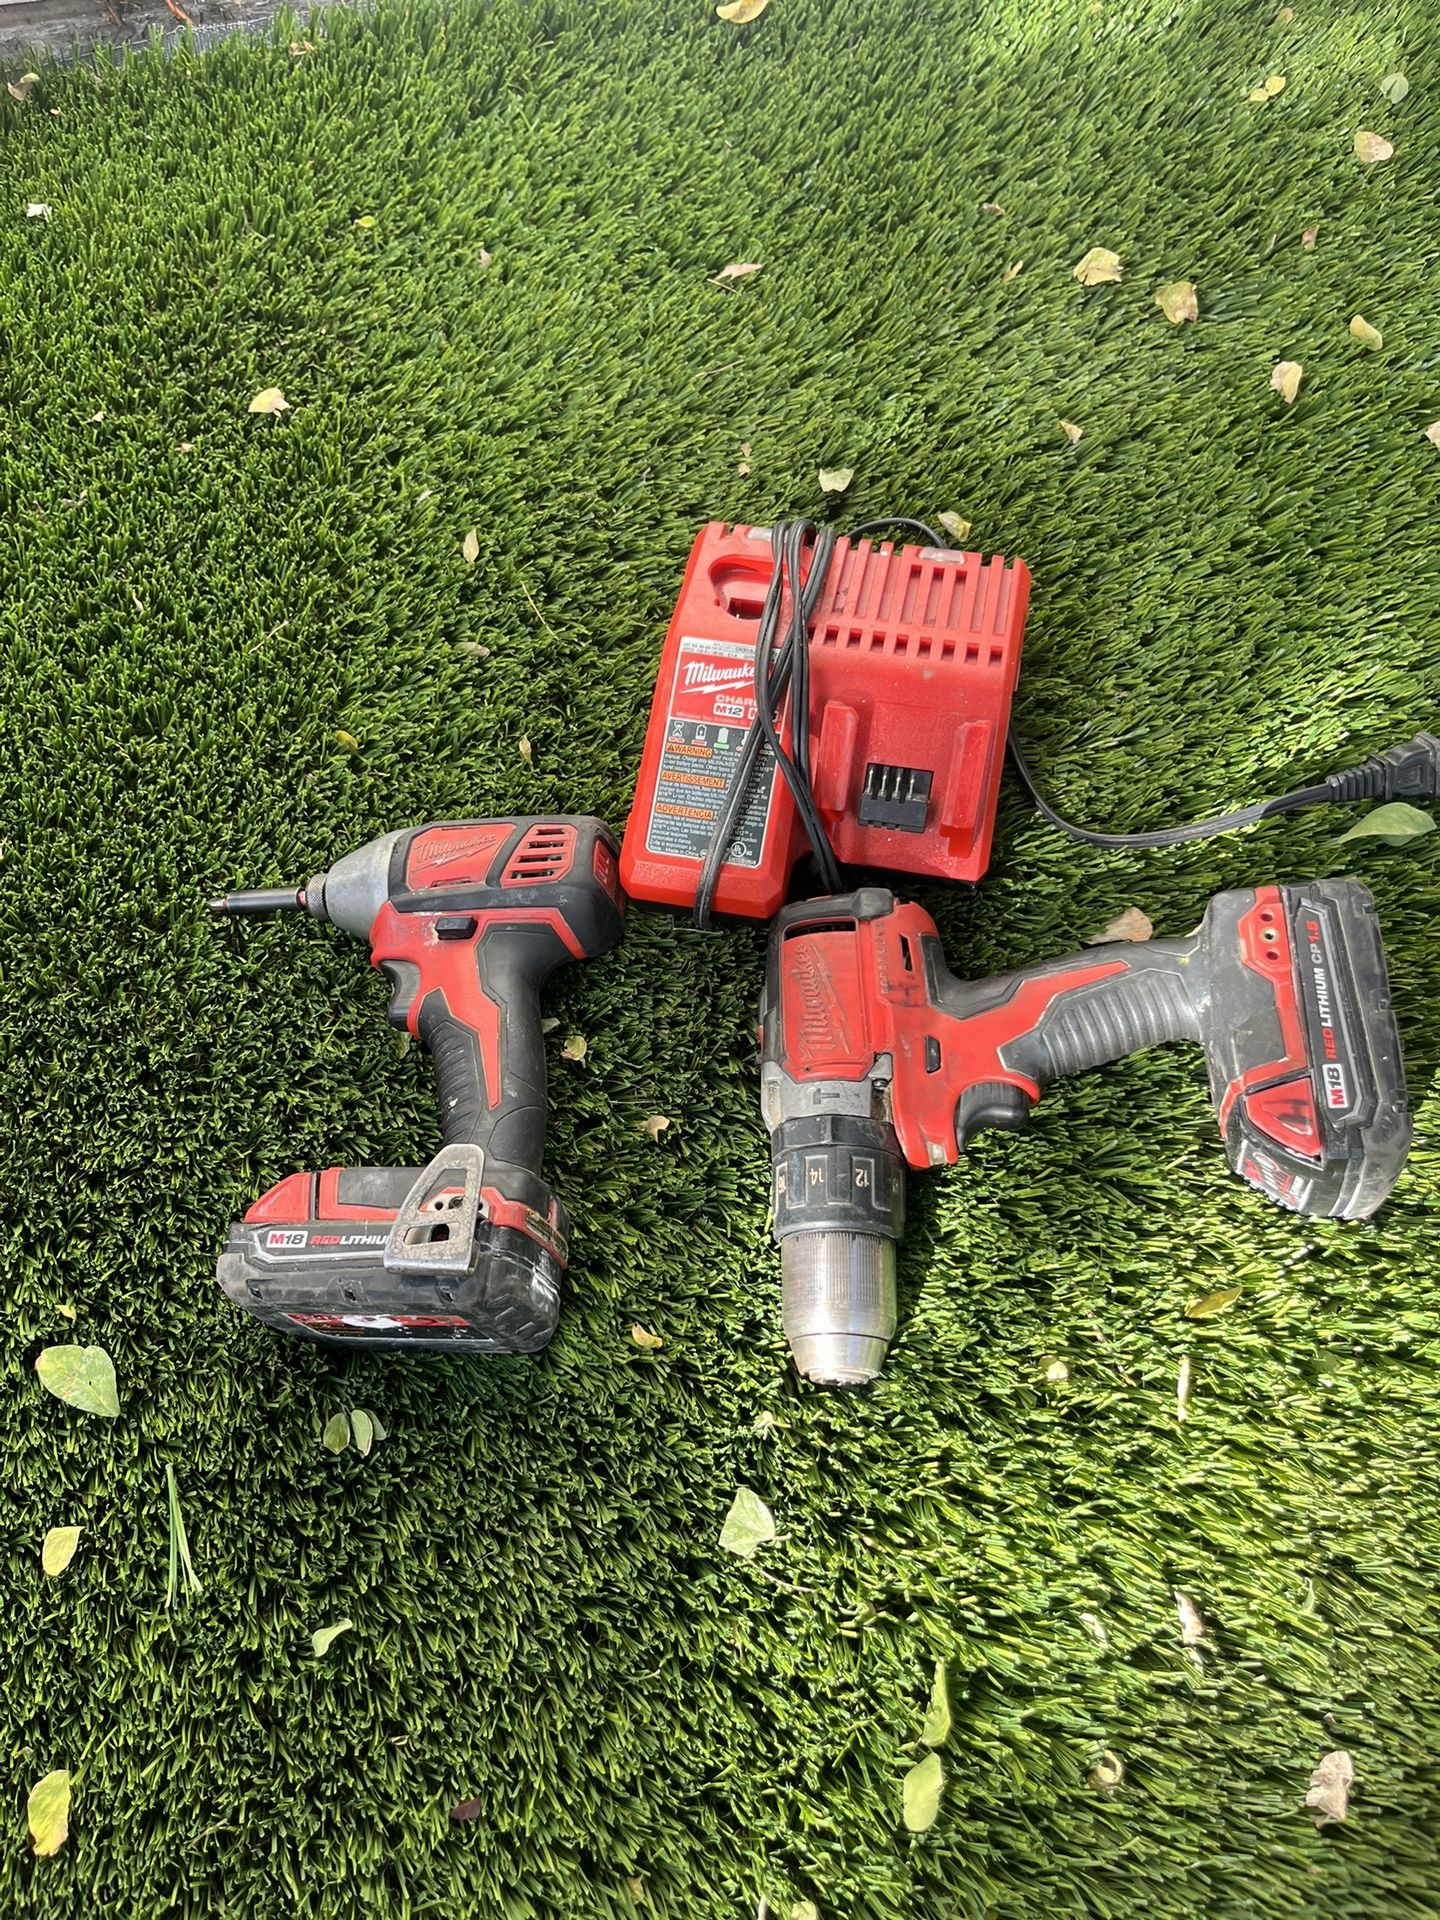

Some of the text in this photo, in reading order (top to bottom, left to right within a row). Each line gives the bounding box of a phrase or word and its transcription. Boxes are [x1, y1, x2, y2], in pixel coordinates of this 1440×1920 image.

[682, 660, 755, 686] Milwauke
[715, 693, 757, 706] CHAR
[715, 704, 743, 717] M12
[674, 745, 712, 757] WARNING
[662, 771, 723, 787] AVERTISSEMENT
[657, 803, 712, 819] ADVERTENCIA
[413, 832, 499, 865] Milwaukee
[792, 942, 838, 1060] Milwaukee
[1313, 967, 1337, 1060] REDLITHIUM
[1326, 1066, 1344, 1107] M18
[810, 1167, 825, 1187] 14
[854, 1168, 870, 1188] 12
[270, 1233, 390, 1245] M18 REDLITHIU
